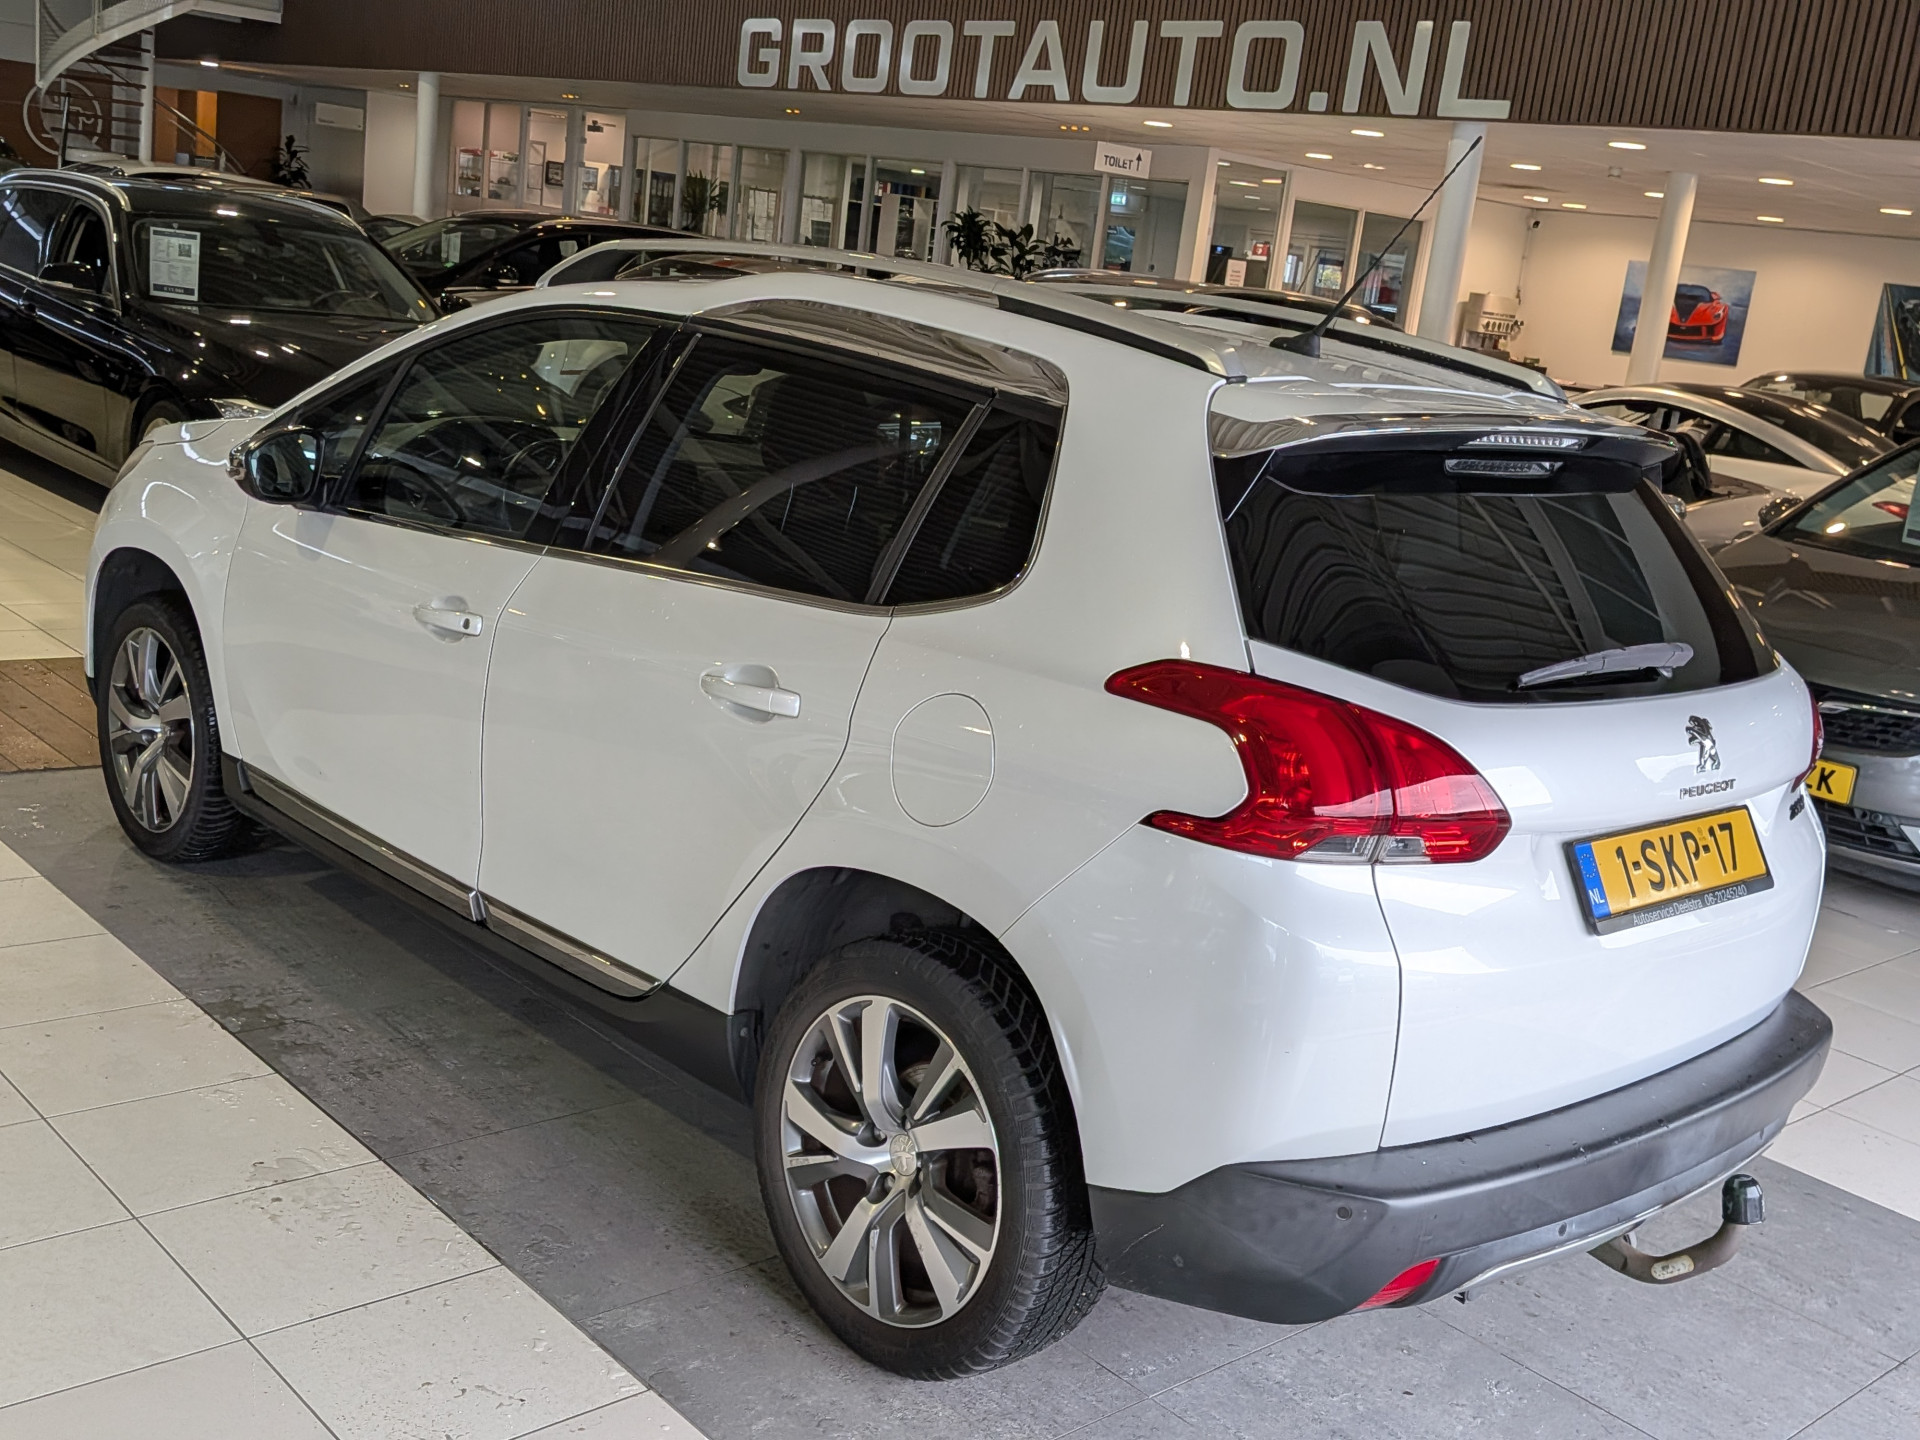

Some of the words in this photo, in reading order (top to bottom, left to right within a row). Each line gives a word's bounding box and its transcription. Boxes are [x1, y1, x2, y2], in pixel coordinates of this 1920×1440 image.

[737, 17, 1510, 120] GROOTAUTO.NL
[1104, 154, 1133, 170] TOILET
[1679, 778, 1737, 800] PEUGEOT
[1615, 821, 1738, 898] 1-SKP-17
[1588, 887, 1606, 906] NL
[1632, 906, 1675, 926] Autoservice
[1674, 897, 1703, 917] Deelstra
[1704, 884, 1748, 906] 06-21245240
